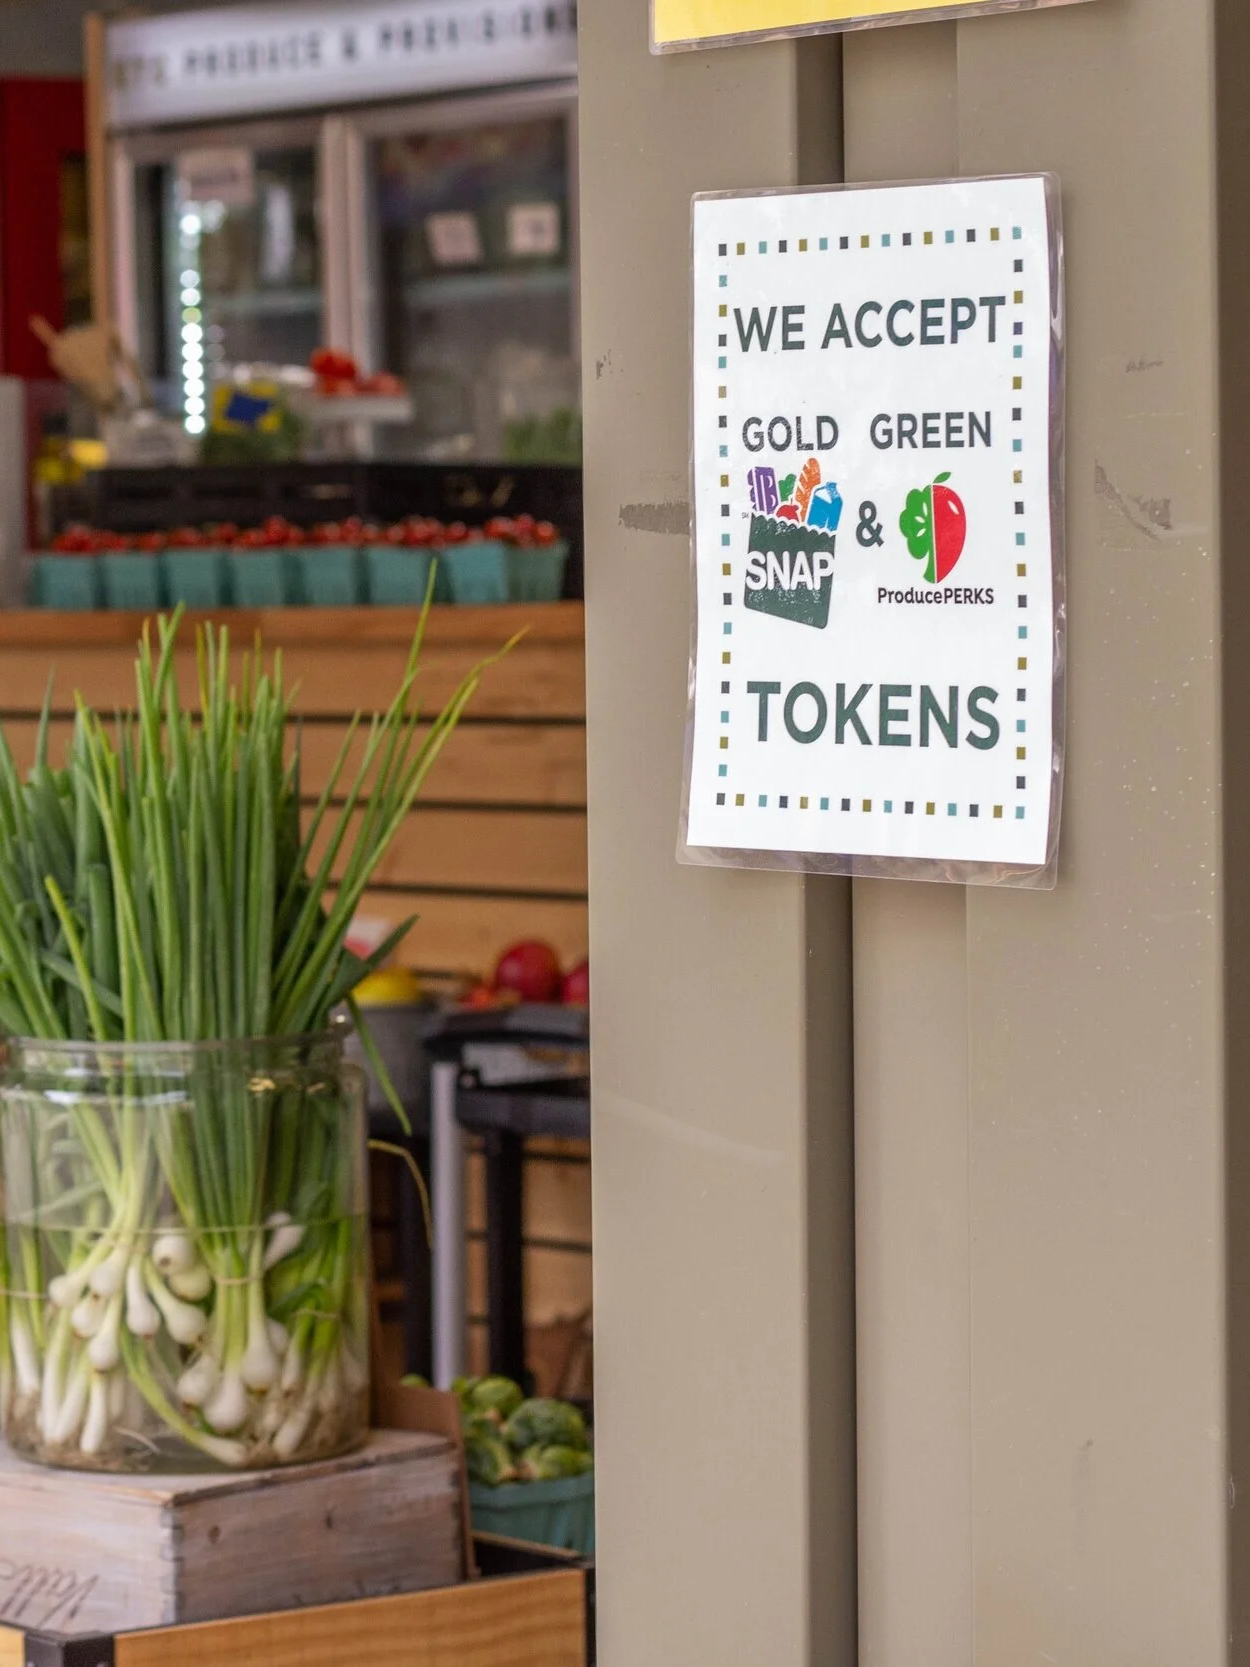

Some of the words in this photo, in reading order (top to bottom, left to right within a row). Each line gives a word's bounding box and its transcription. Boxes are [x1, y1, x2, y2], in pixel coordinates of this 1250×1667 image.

[733, 305, 805, 352] WE
[821, 296, 1006, 349] ACCEPT
[742, 415, 839, 452] GOLD
[870, 411, 992, 450] GREEN
[856, 500, 885, 547] &
[745, 550, 835, 591] SNAP
[878, 587, 995, 605] ProducePERKS
[747, 681, 1001, 750] TOKENS
